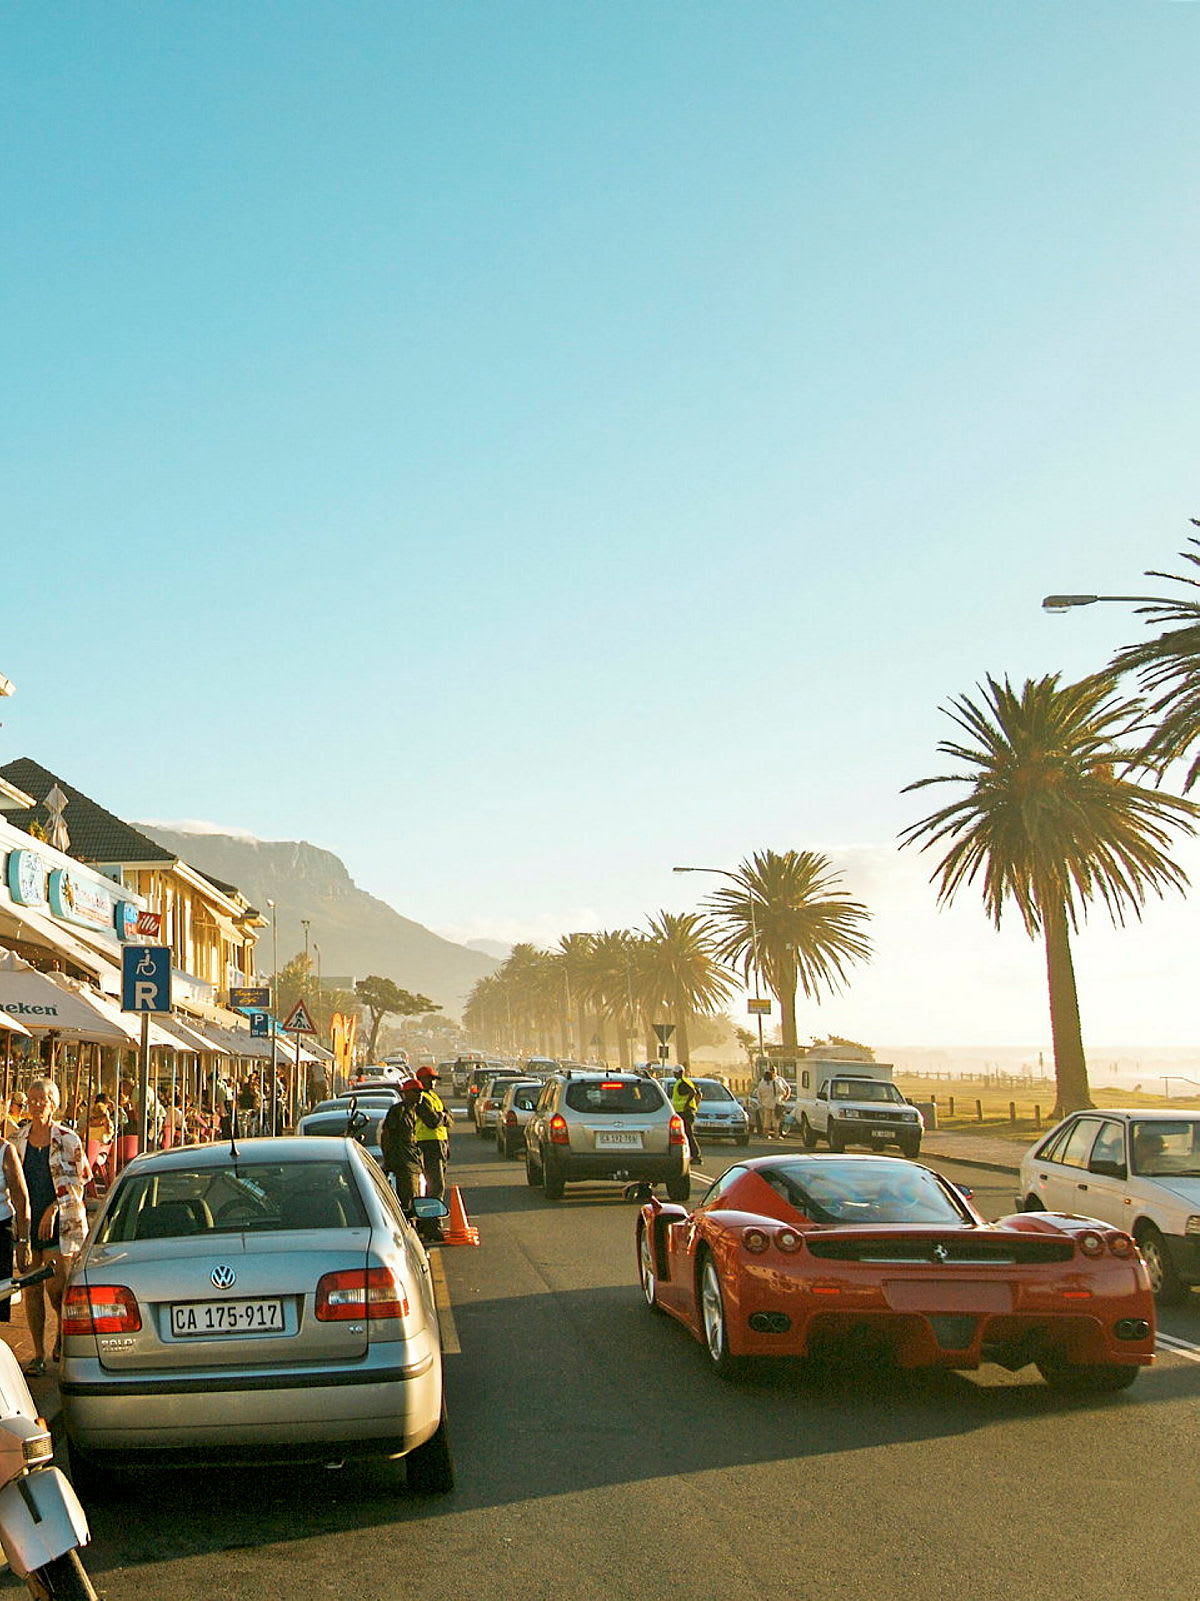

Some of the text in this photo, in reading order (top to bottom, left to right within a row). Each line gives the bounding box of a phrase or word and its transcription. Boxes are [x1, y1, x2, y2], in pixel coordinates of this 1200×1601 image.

[140, 914, 159, 934] illy
[135, 981, 158, 1009] R
[255, 1014, 264, 1026] P
[176, 1305, 277, 1330] CA 175-917
